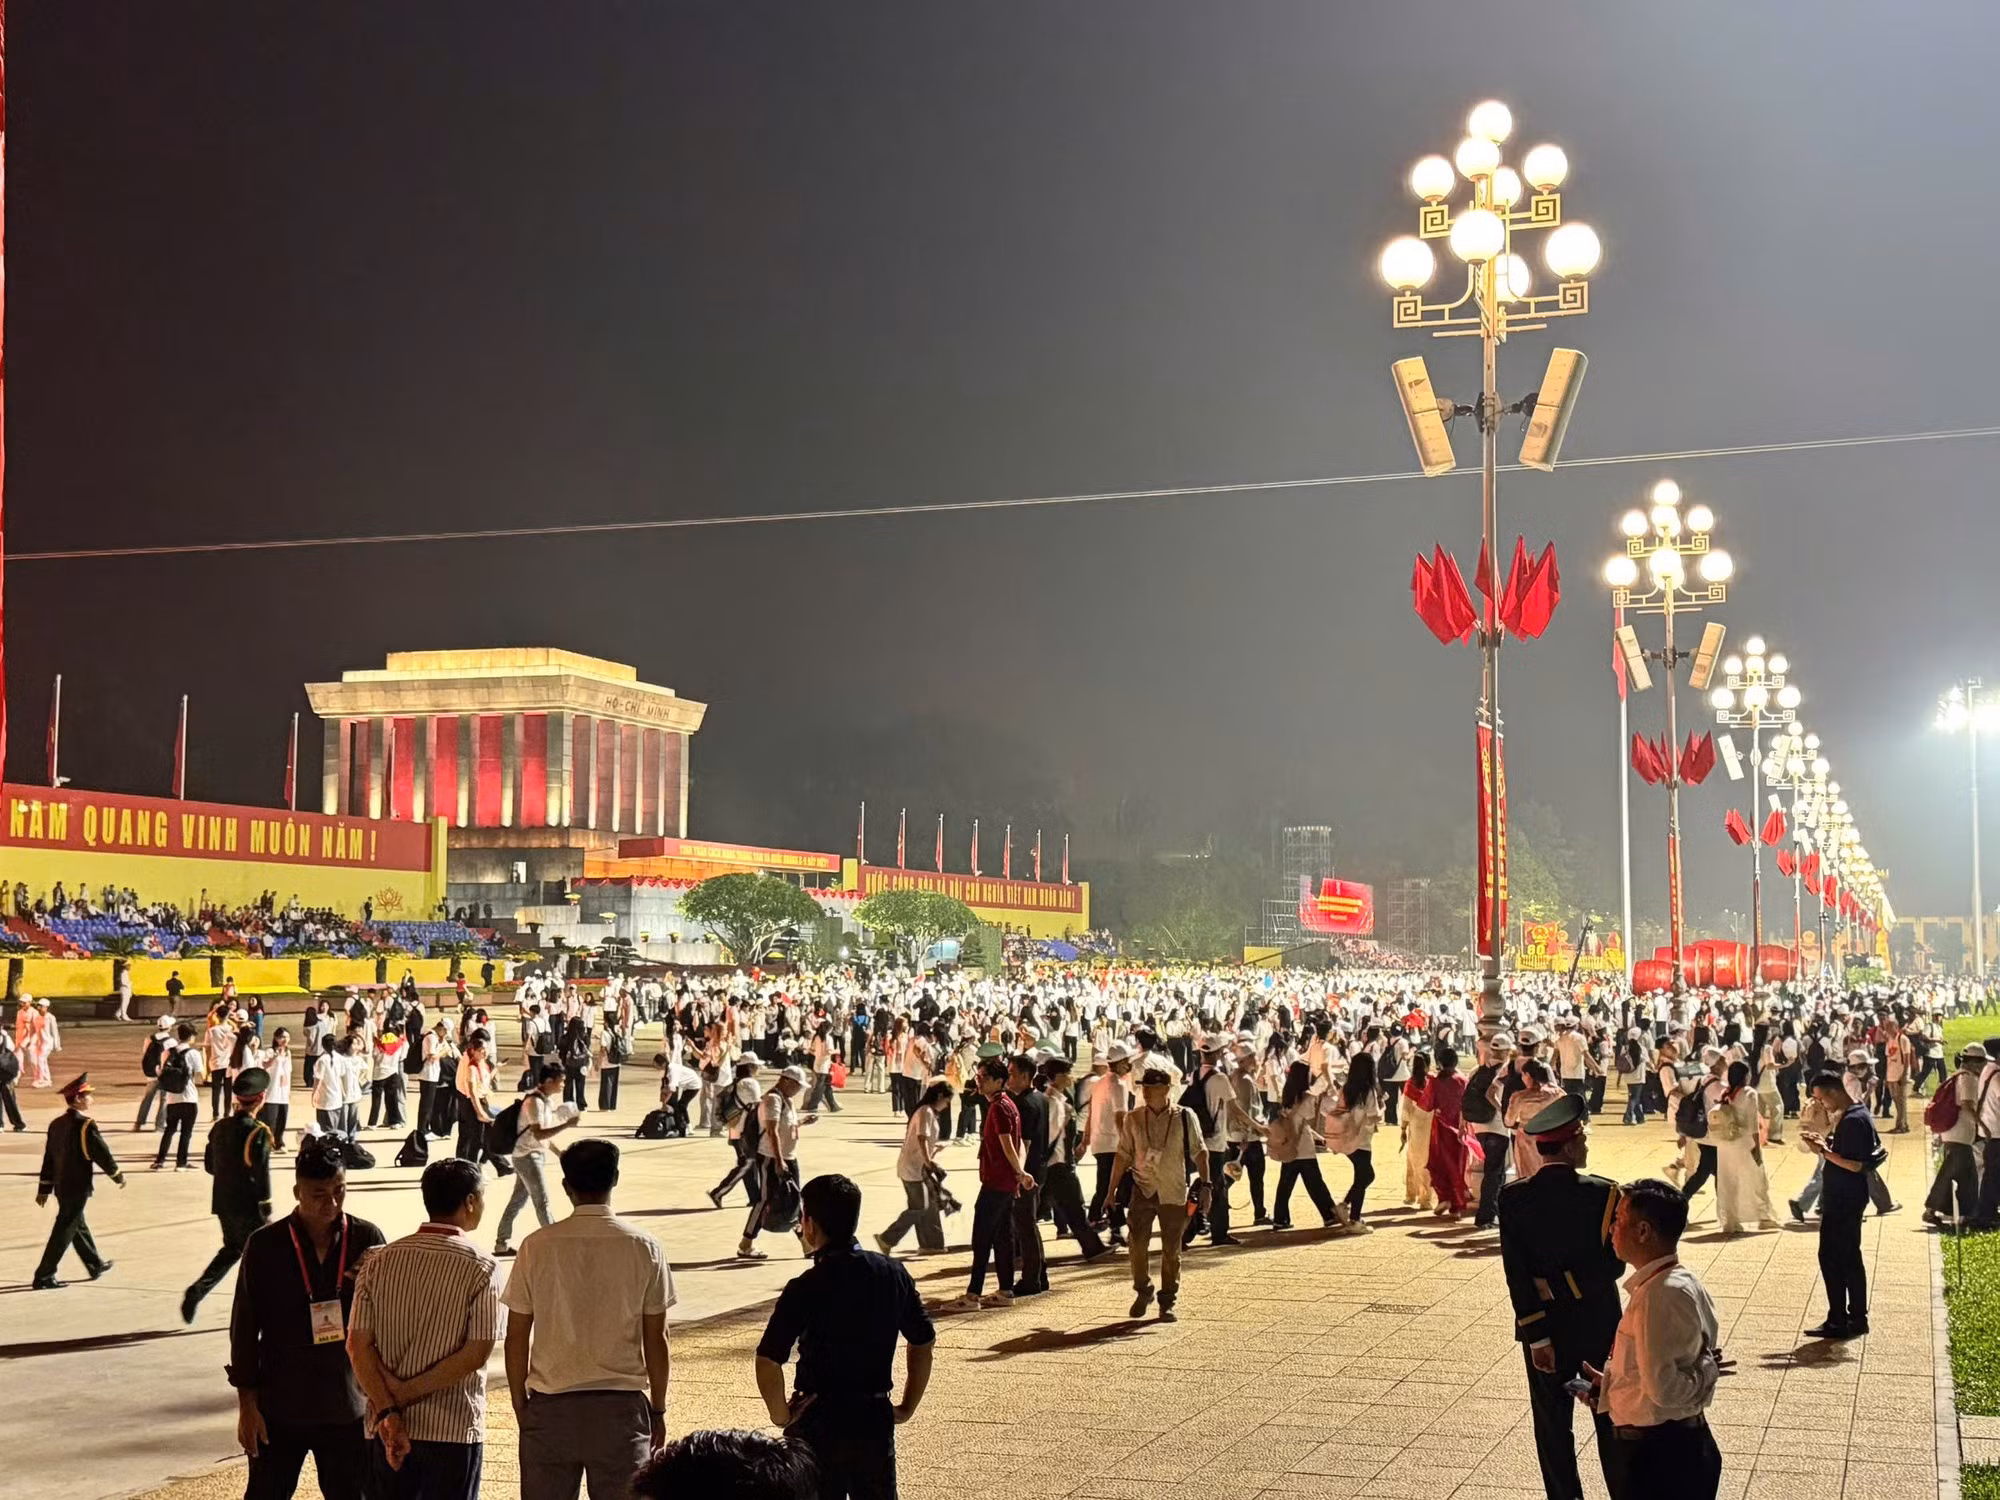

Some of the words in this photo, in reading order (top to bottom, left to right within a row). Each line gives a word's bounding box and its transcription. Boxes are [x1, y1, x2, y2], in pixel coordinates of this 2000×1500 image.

[83, 805, 168, 848] QUANG
[182, 814, 237, 852] VINH
[250, 817, 310, 857] MUÔN
